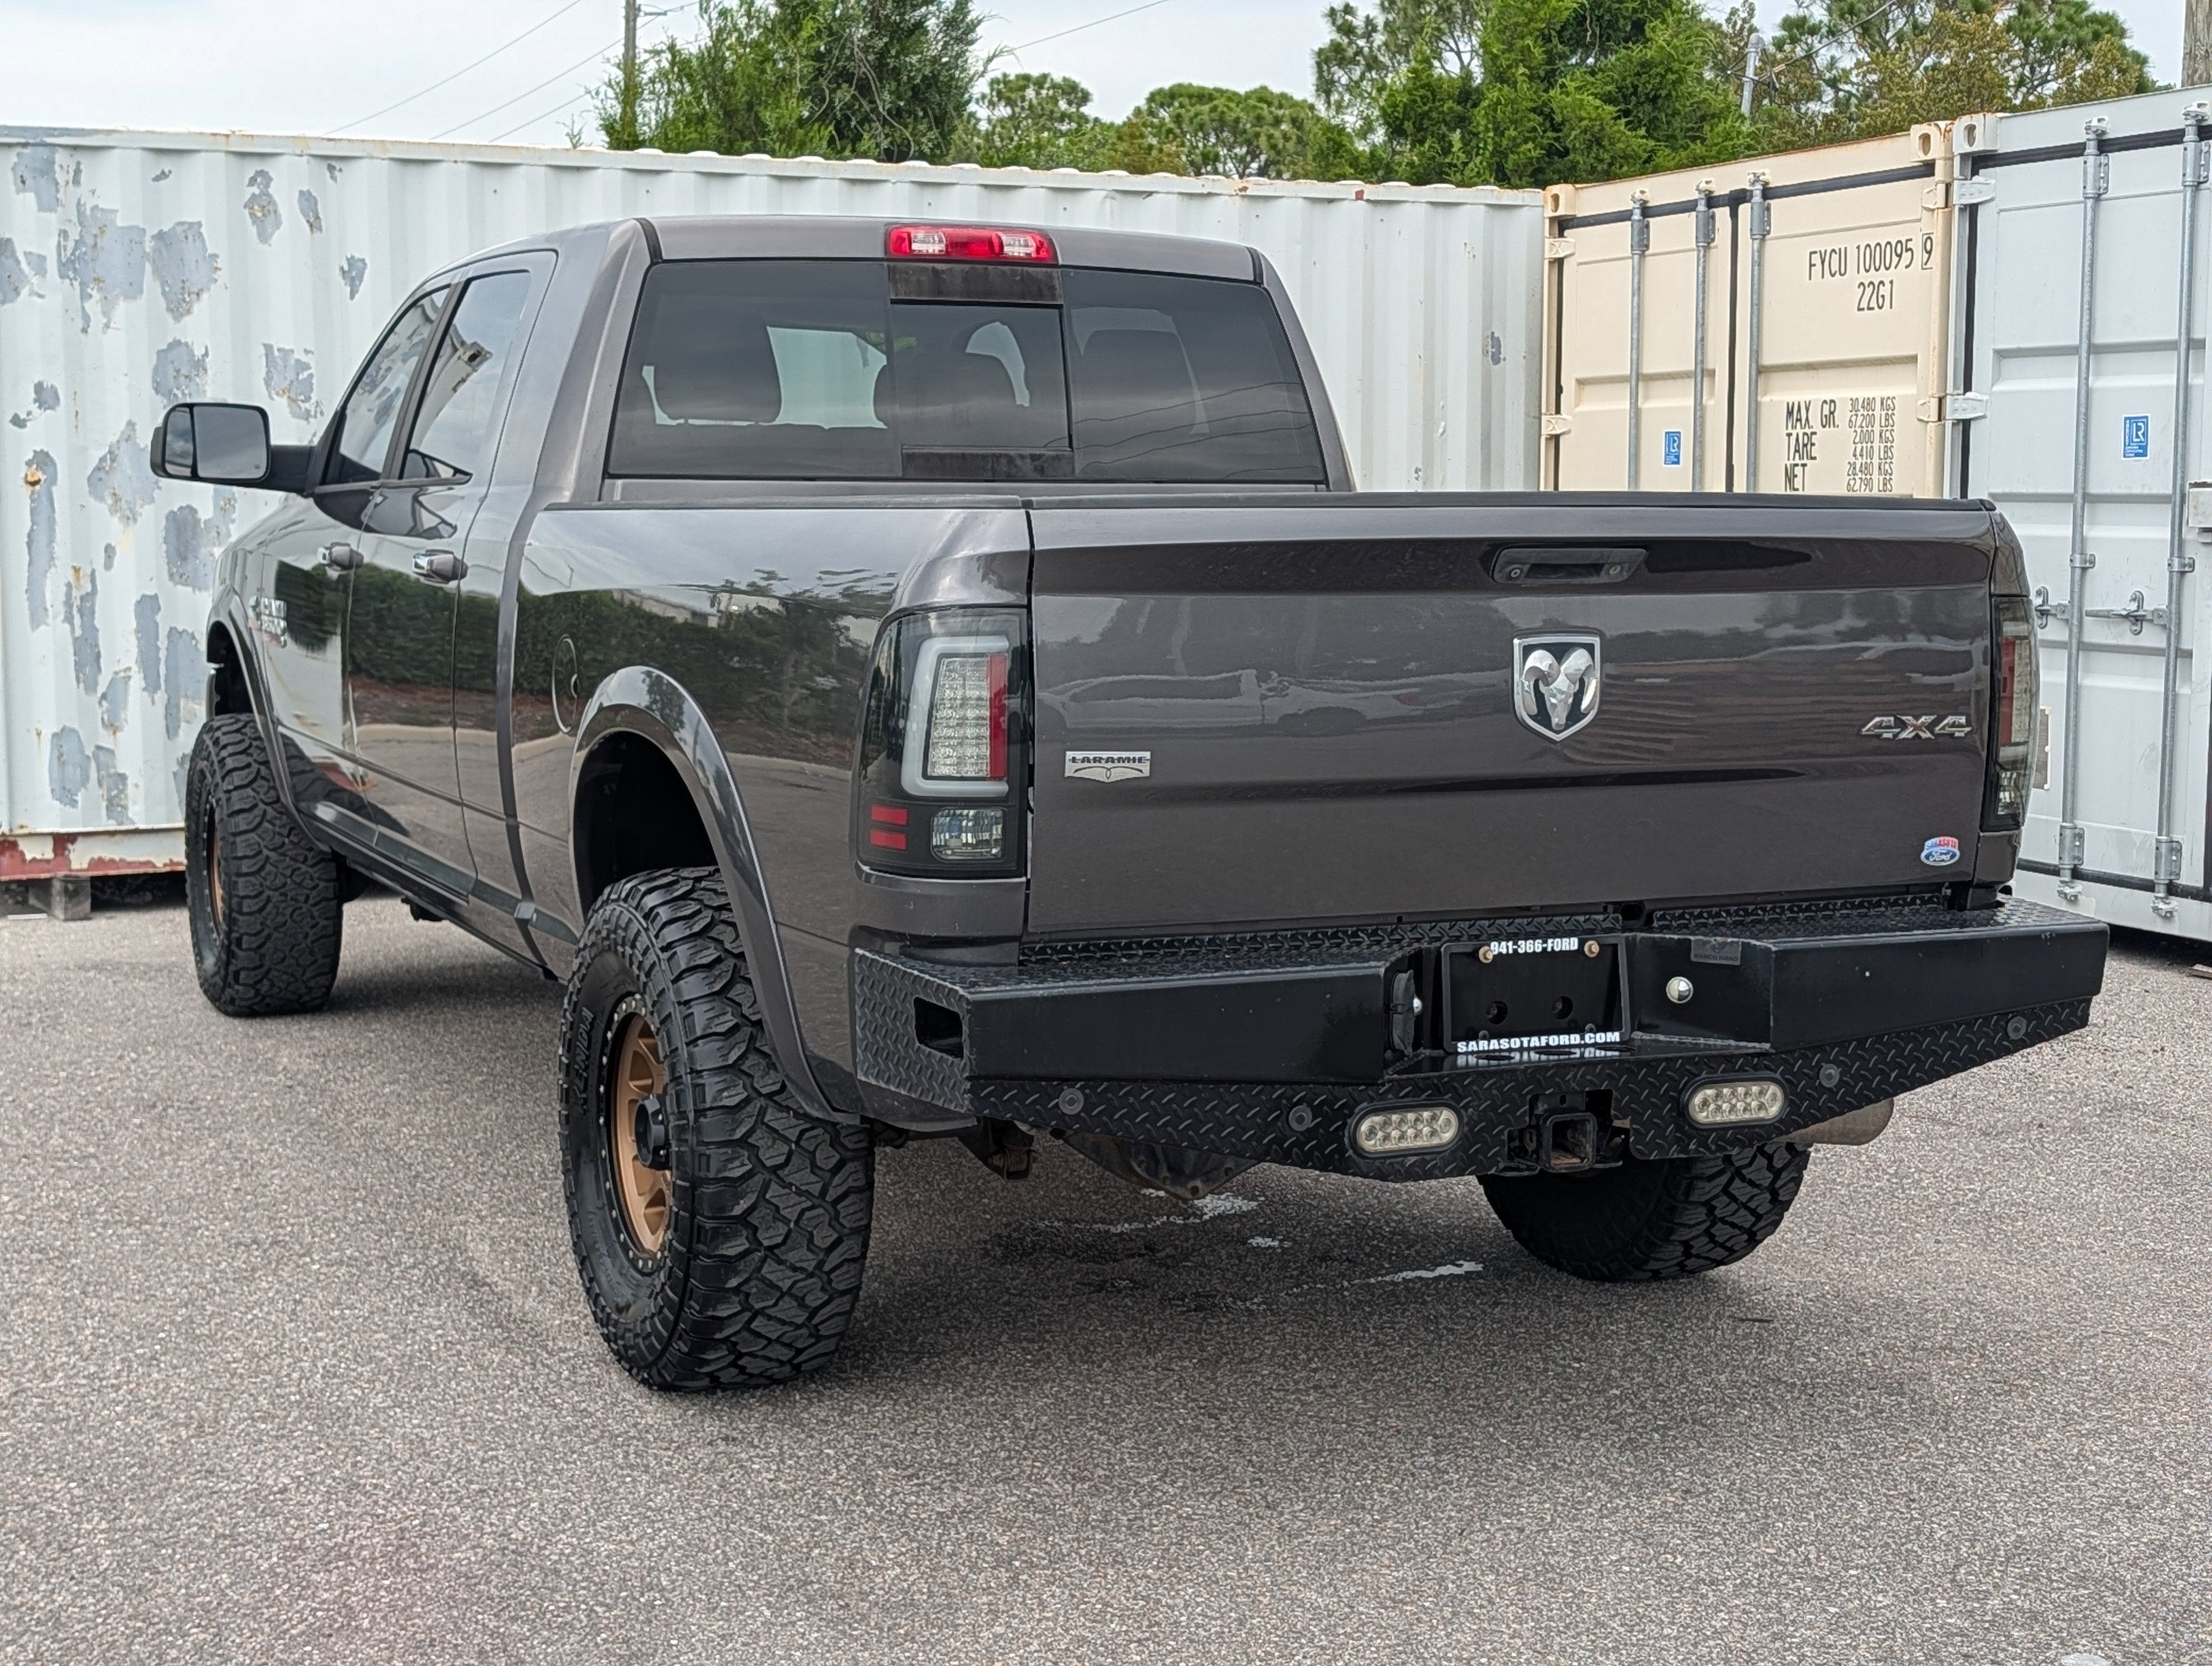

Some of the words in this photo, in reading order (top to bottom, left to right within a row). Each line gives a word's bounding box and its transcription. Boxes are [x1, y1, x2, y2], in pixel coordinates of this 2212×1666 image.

[1808, 247, 1848, 281] FYCU
[1856, 238, 1914, 274] 100095
[1924, 235, 1934, 266] 9
[1857, 279, 1894, 312] 22G1
[1785, 400, 1814, 431] MAX.
[1820, 399, 1840, 429] GR.
[1880, 396, 1896, 412] KGS
[1879, 413, 1895, 428] LBS
[1785, 432, 1817, 462] TARE
[1879, 430, 1894, 444] KGS
[1878, 445, 1894, 460] LBS
[1784, 463, 1808, 492] NET
[1877, 462, 1894, 476] KGS
[1877, 477, 1893, 492] LBS
[1929, 850, 1952, 861] Ford
[1490, 937, 1579, 954] 941-366-FORD
[1457, 1031, 1620, 1053] SARASOTAFORD.COM
